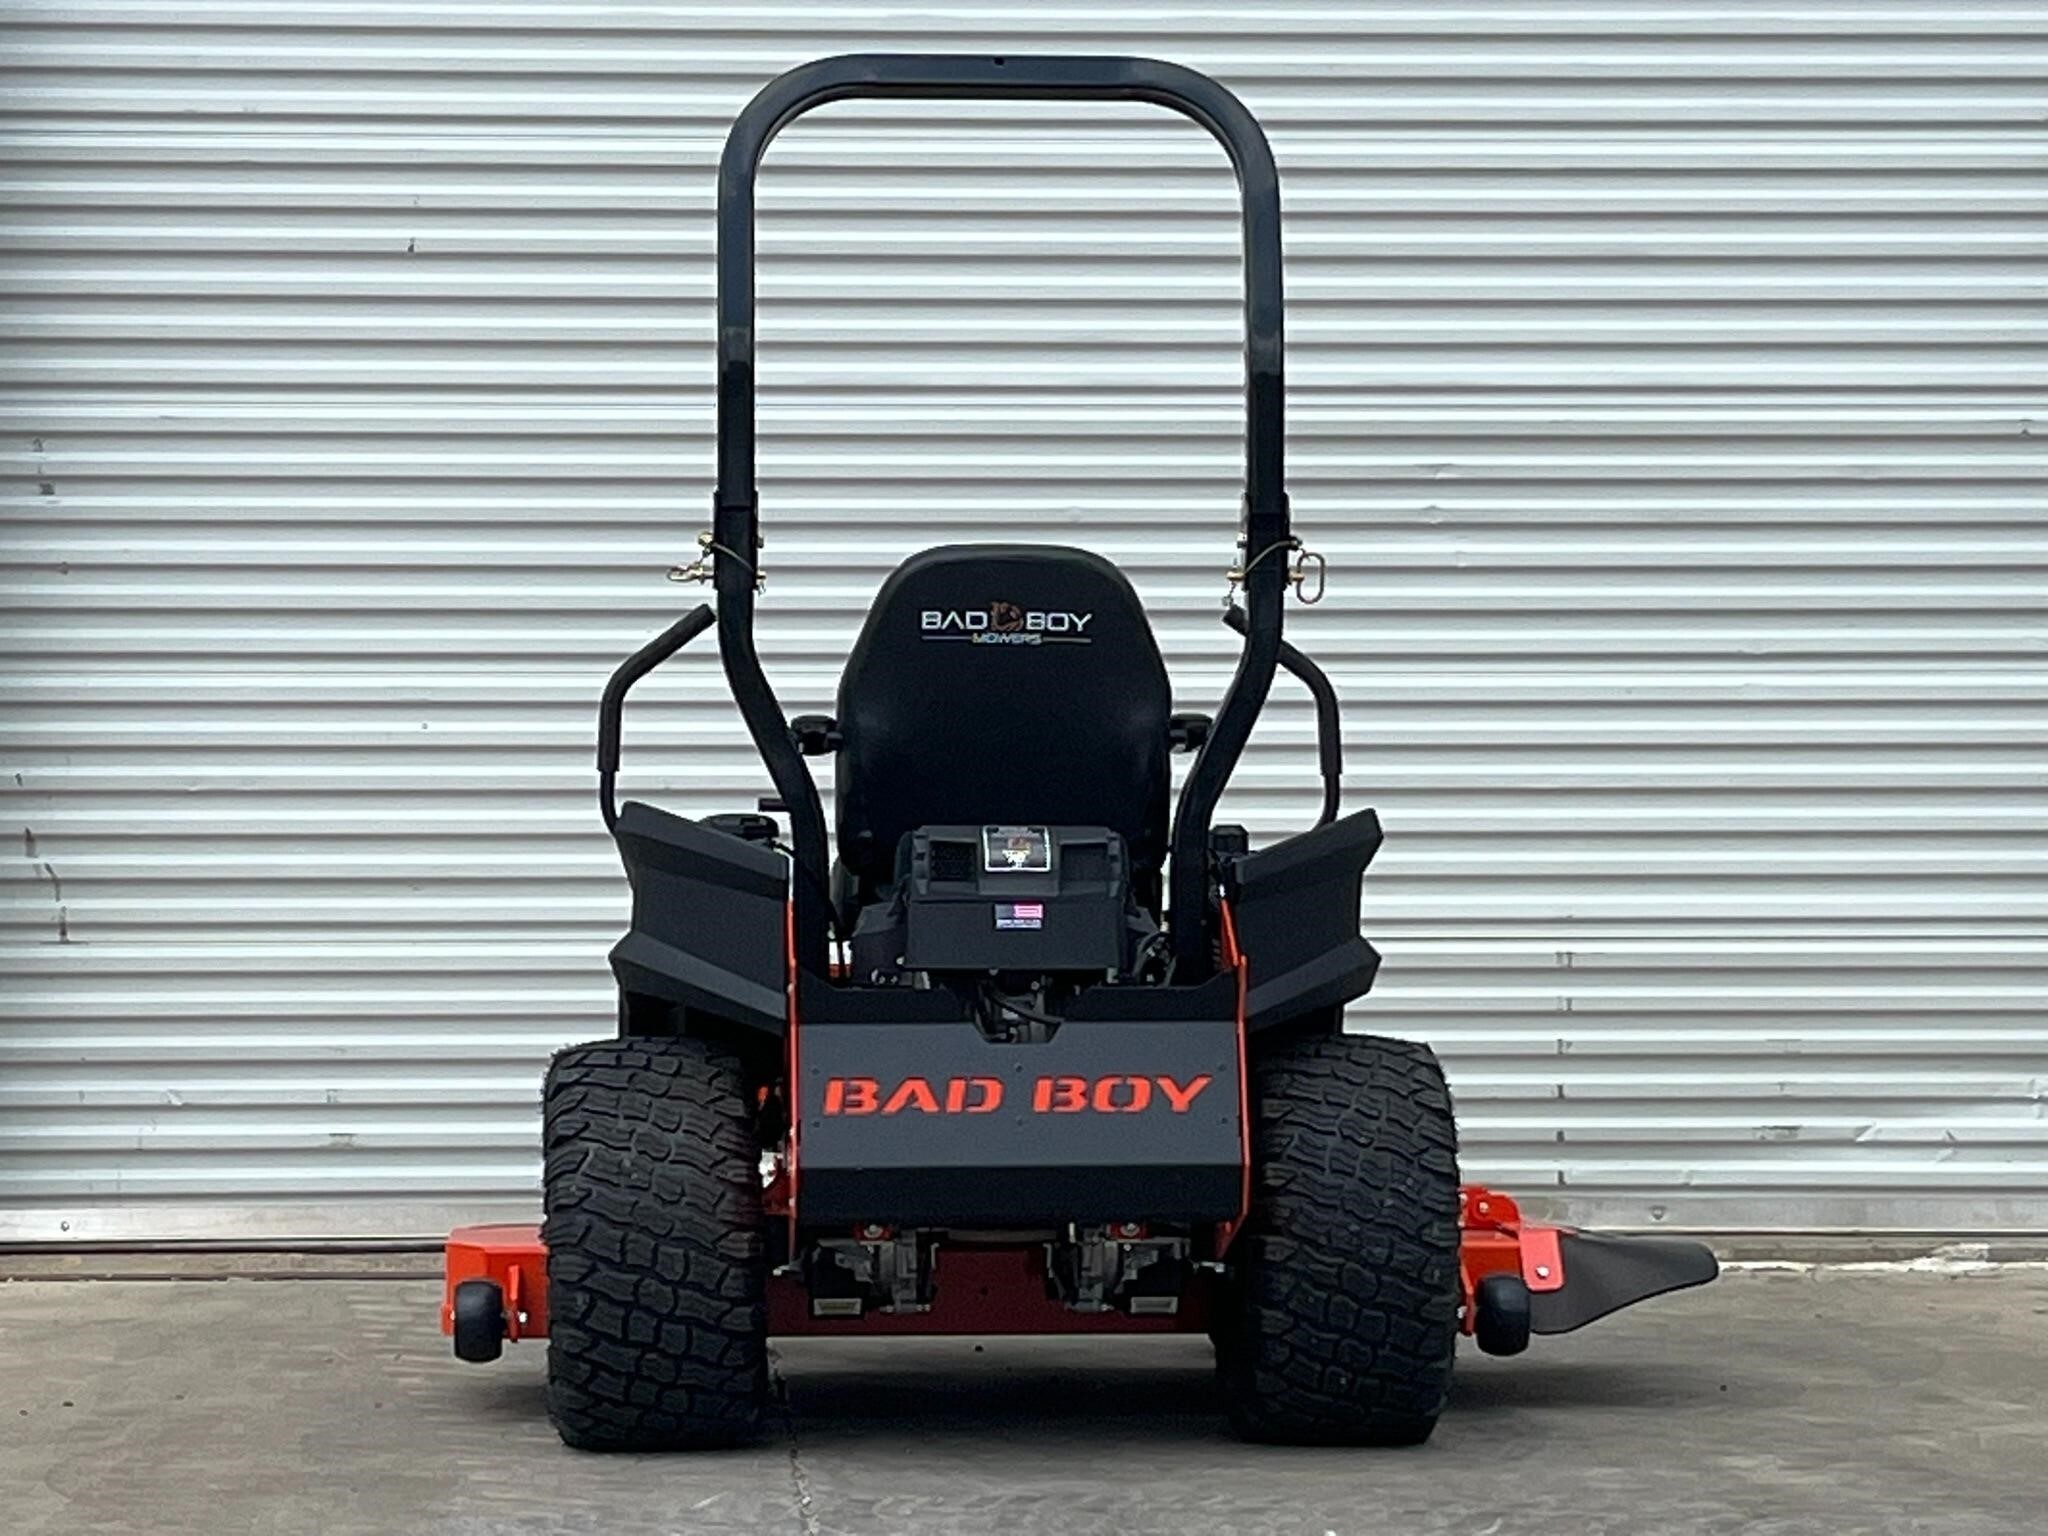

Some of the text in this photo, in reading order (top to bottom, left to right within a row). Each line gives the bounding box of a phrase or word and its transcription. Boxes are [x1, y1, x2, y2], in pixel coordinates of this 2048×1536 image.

[921, 611, 1092, 631] BAD BOY
[972, 633, 1042, 644] MOWERS
[823, 1074, 1212, 1115] BAD BOY
